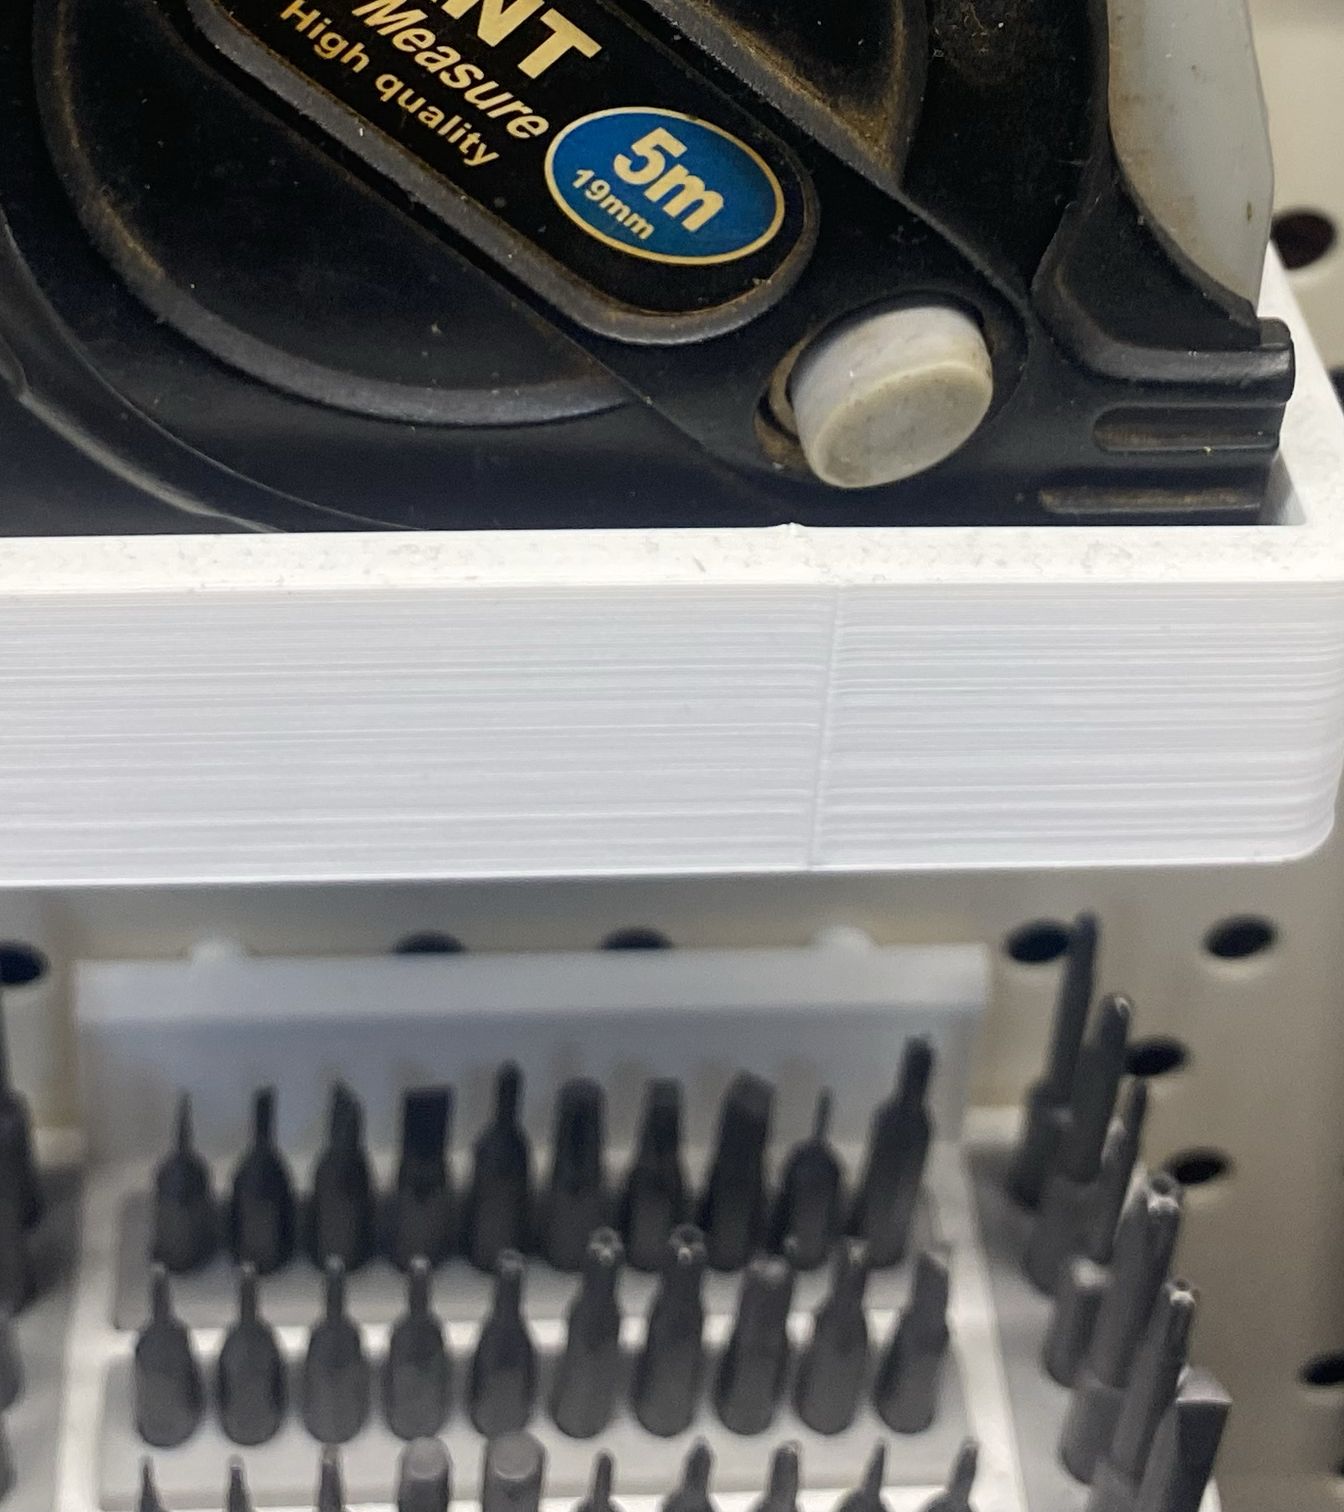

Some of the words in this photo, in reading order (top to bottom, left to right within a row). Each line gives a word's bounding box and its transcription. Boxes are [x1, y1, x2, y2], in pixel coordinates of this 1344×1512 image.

[374, 69, 500, 167] quality
[572, 166, 656, 240] 19mm
[612, 126, 726, 233] 5m
